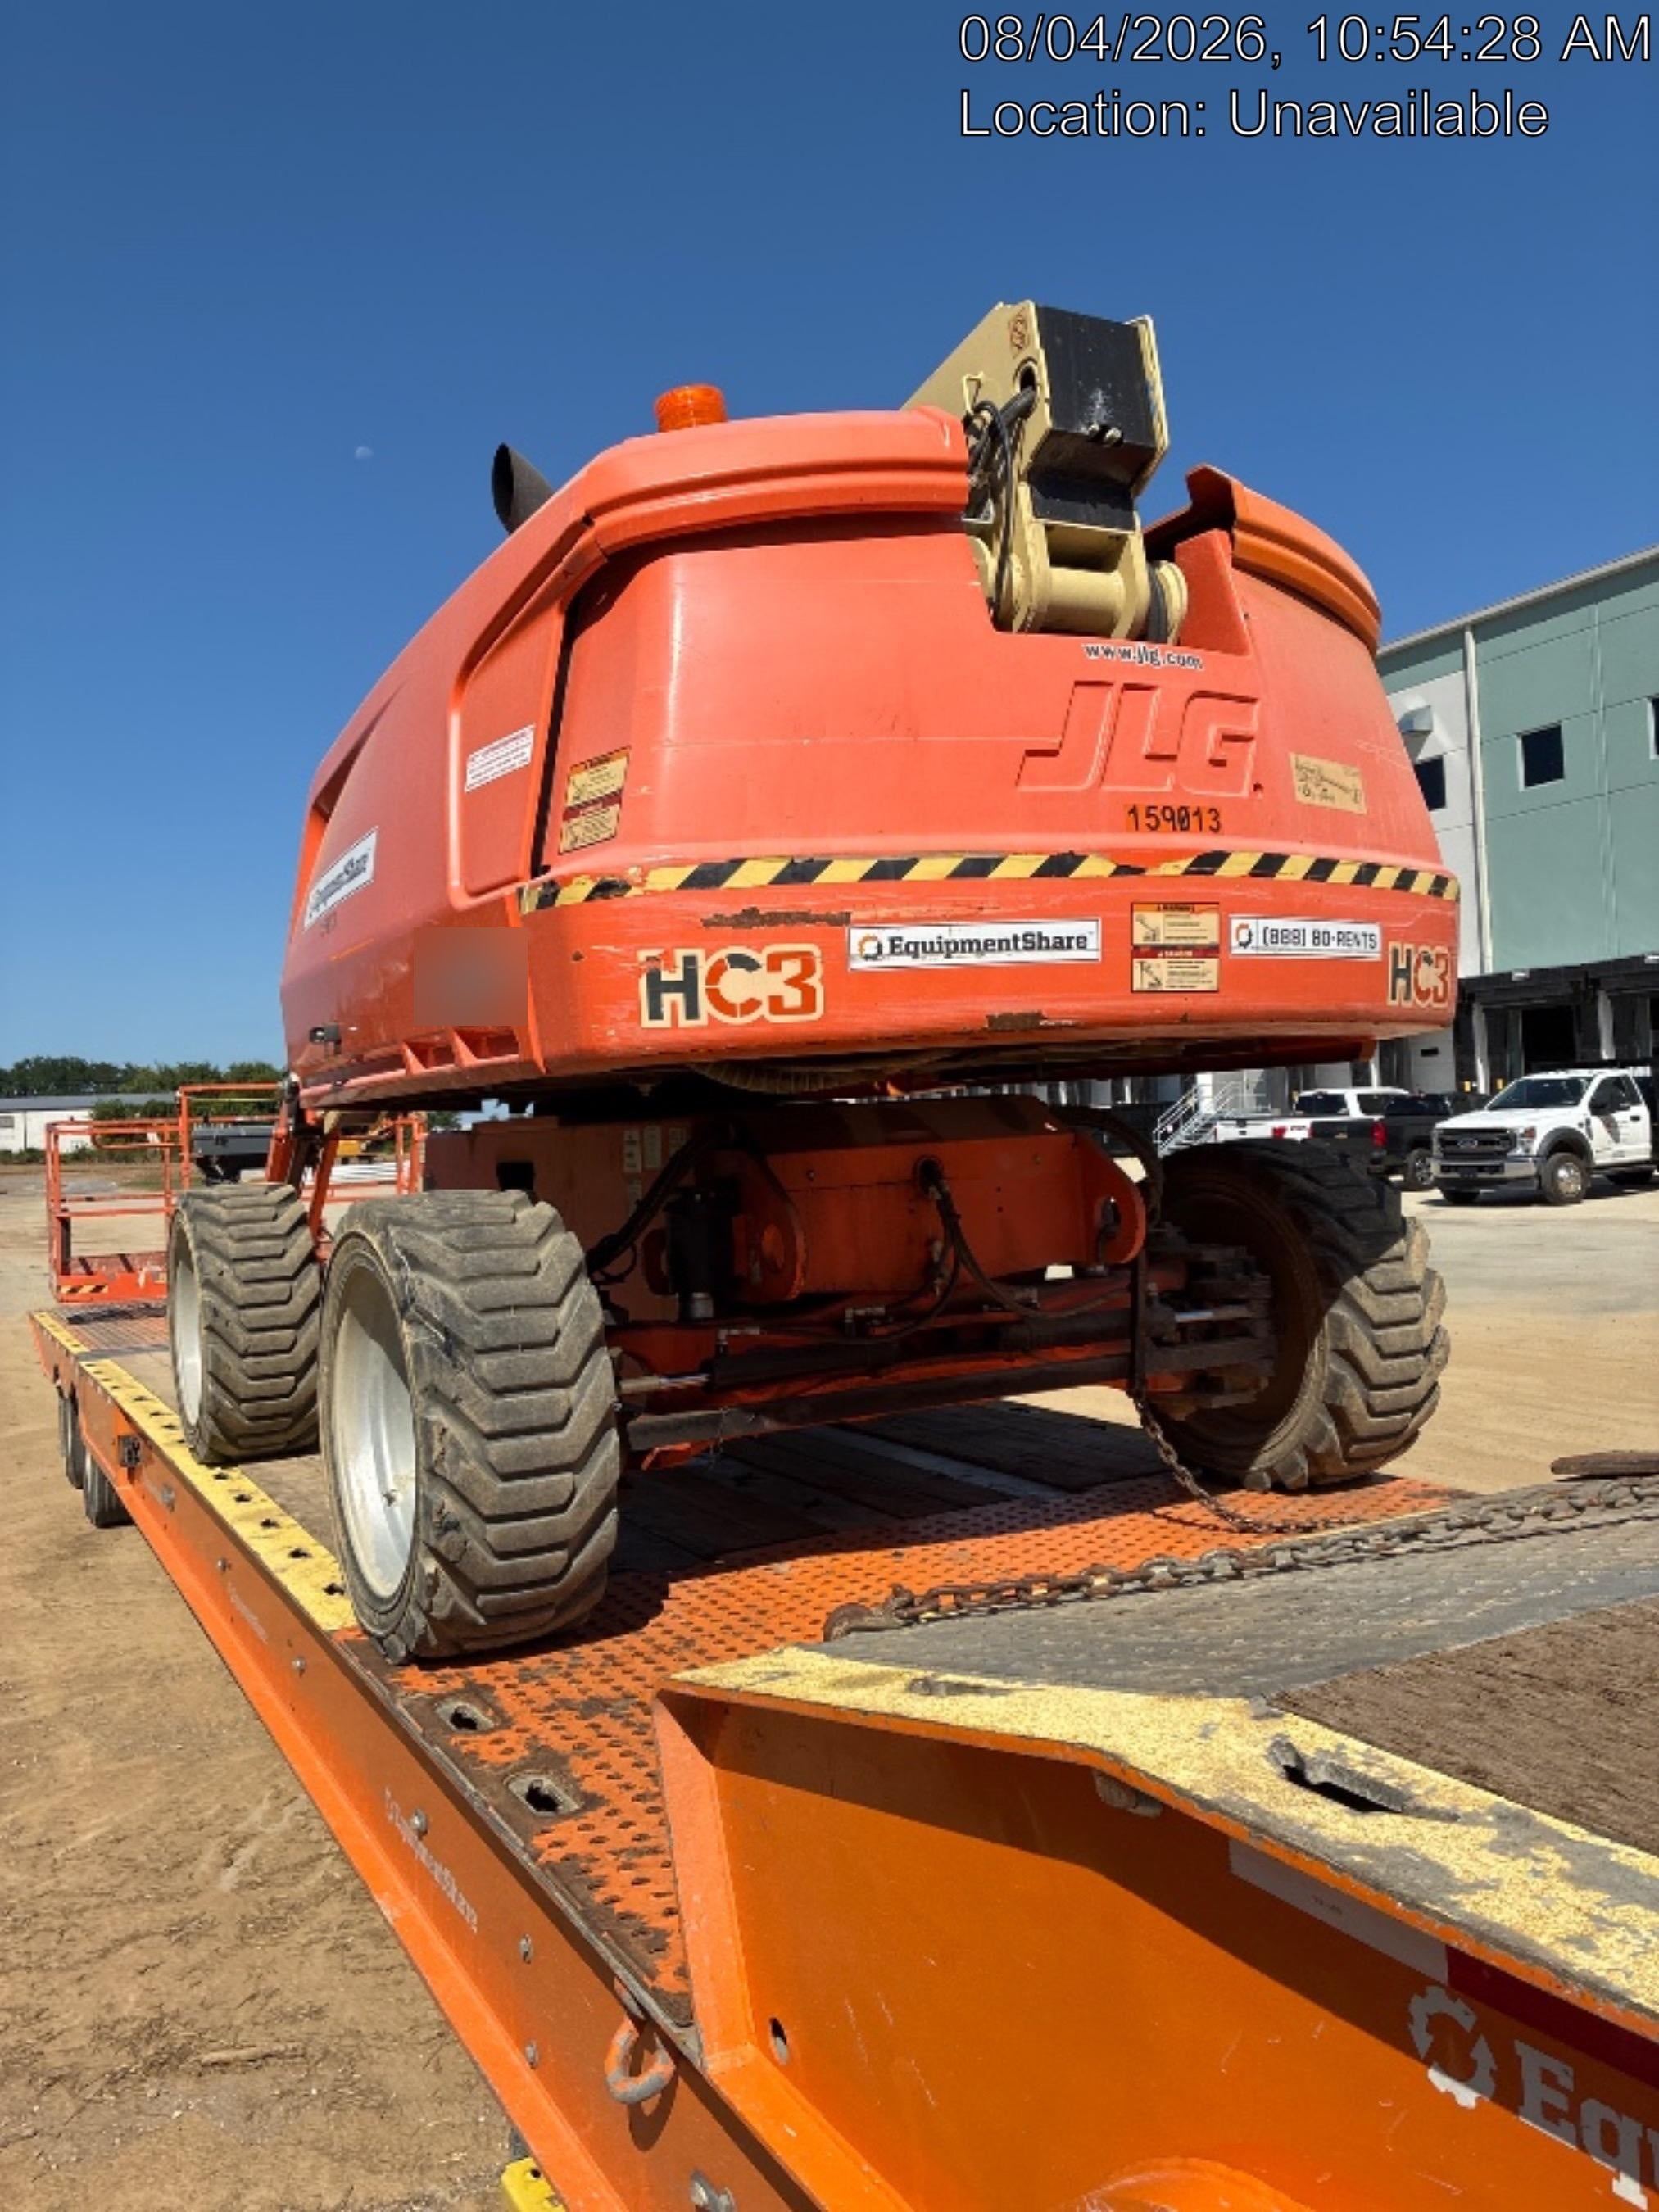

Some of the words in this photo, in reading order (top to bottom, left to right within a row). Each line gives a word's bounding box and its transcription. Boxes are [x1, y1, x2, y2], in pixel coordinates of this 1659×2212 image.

[1084, 644, 1204, 669] www.jlg.com
[1016, 681, 1260, 798] JLG
[1128, 804, 1222, 834] 159013
[889, 931, 1088, 959] EquipmentShare
[641, 945, 822, 1025] HC3
[1389, 945, 1451, 1007] HC3
